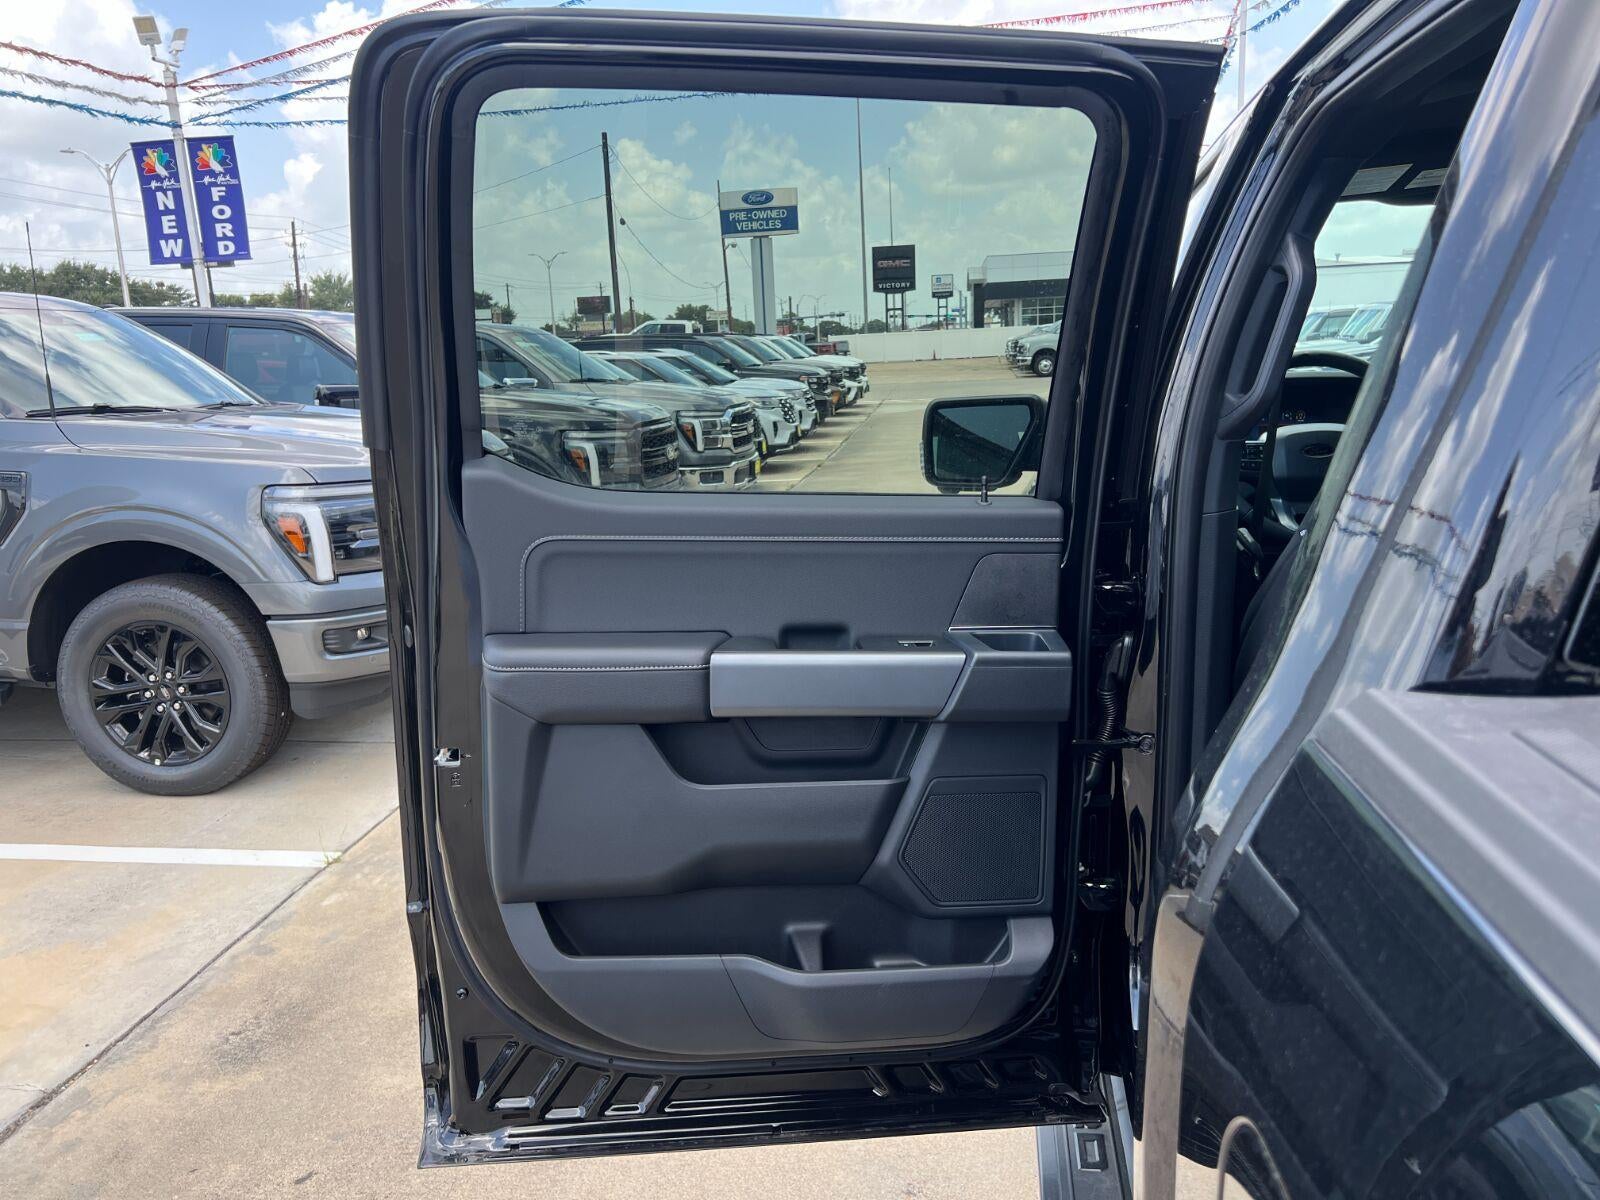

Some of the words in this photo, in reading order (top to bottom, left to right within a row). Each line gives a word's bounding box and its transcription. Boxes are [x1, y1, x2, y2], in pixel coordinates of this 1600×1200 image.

[729, 209, 787, 221] PRE-OWNED
[155, 191, 183, 258] NEW
[210, 187, 235, 256] FORD
[736, 220, 782, 230] VEHICLES
[877, 260, 911, 268] GMC
